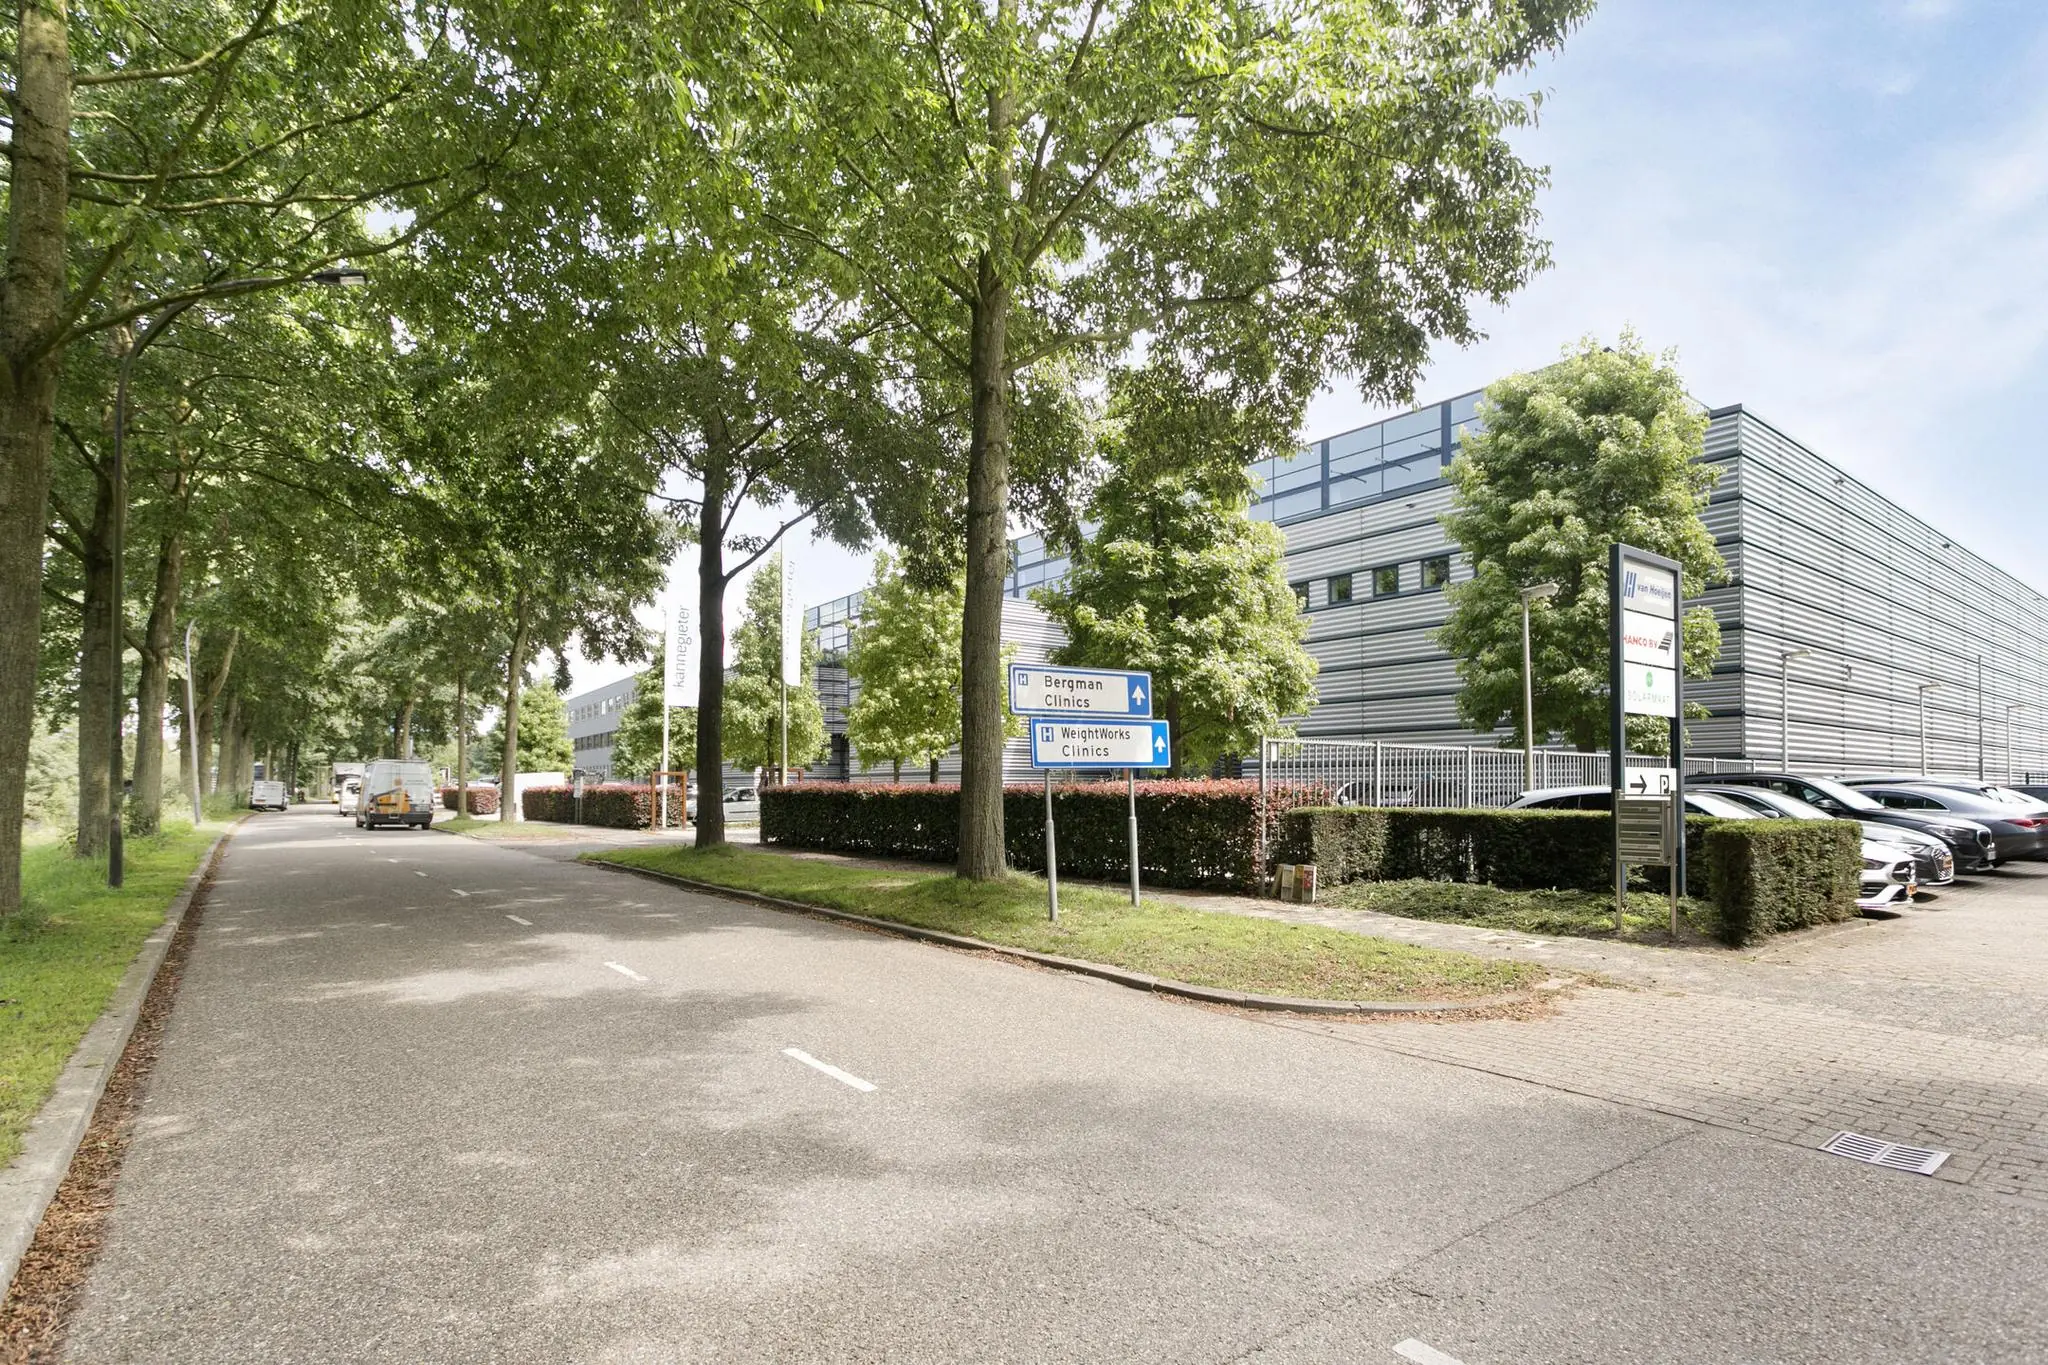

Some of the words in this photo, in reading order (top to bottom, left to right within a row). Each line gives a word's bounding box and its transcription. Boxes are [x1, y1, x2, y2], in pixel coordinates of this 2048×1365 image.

[673, 606, 692, 689] kannegieter
[1044, 675, 1103, 692] Bergman
[1044, 694, 1090, 708] Clinics
[1061, 726, 1131, 743] WeightWorks
[1062, 745, 1109, 757] Clinics
[1660, 775, 1670, 793] P
